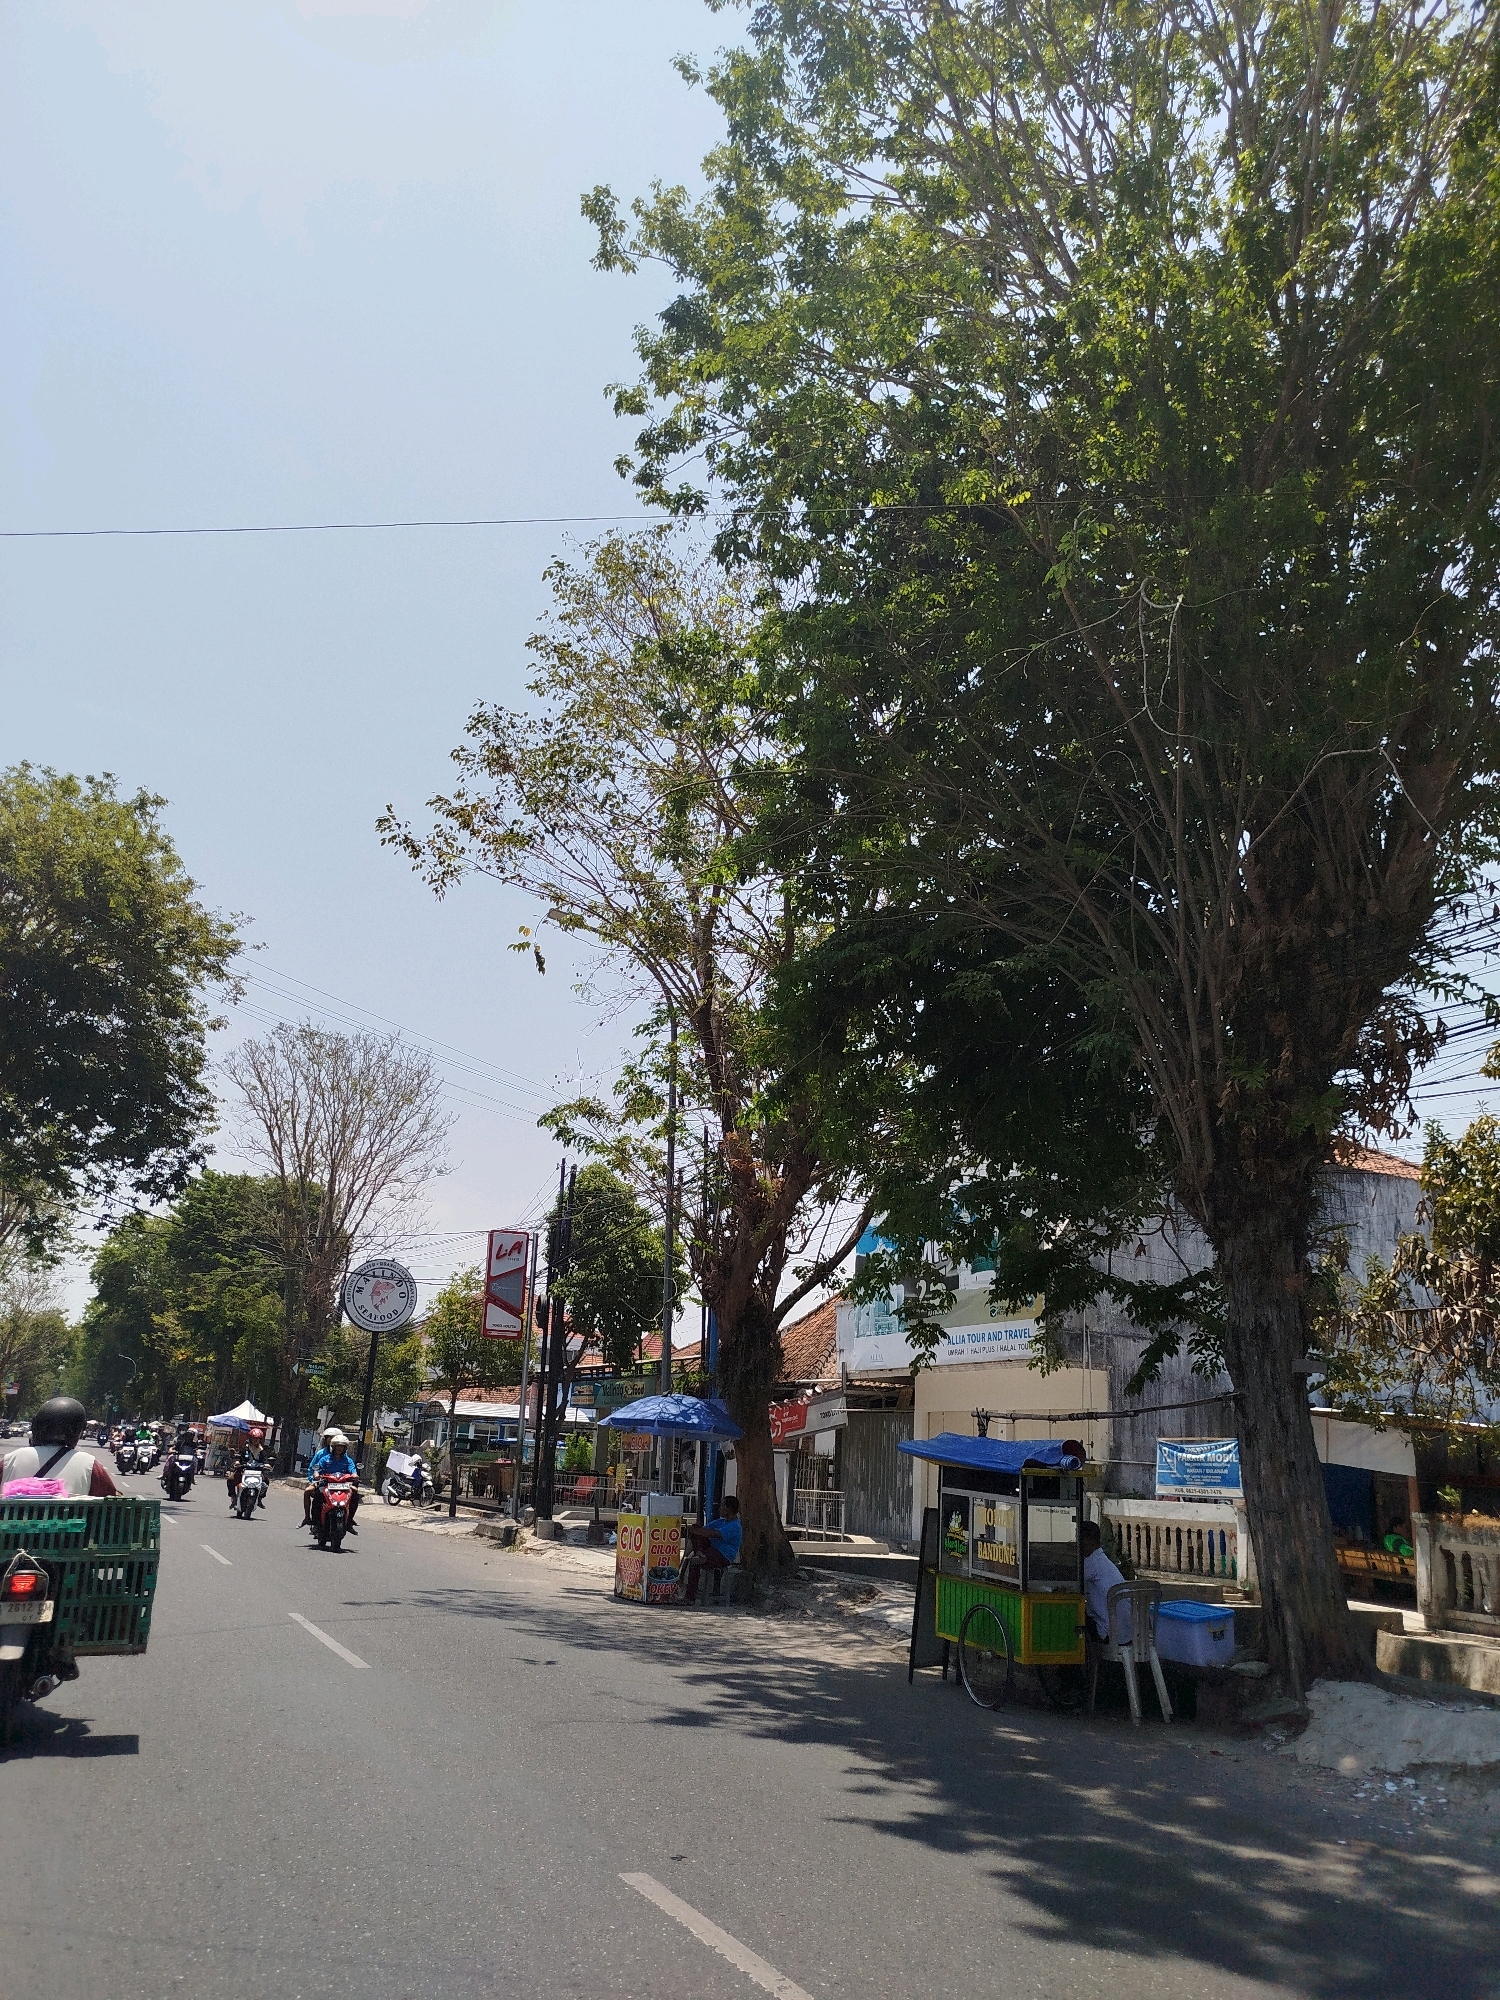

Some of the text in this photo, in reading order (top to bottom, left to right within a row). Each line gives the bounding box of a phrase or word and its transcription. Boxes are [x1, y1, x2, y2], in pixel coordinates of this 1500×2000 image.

[354, 1269, 407, 1299] MALINDO
[358, 1304, 399, 1321] SEAFOOD
[947, 1326, 1032, 1346] ALLIA TOUR AND TRAVEL
[947, 1348, 965, 1357] UMRAH
[970, 1347, 982, 1355] HAJI
[982, 1345, 996, 1354] PLUS
[999, 1343, 1017, 1352] HALAL
[1177, 1452, 1239, 1463] PARKIR MOBIL
[620, 1525, 644, 1553] CIO
[651, 1528, 681, 1541] CIO
[650, 1544, 679, 1555] CILOK
[977, 1541, 1016, 1565] BANDUNG
[657, 1556, 671, 1567] ISI
